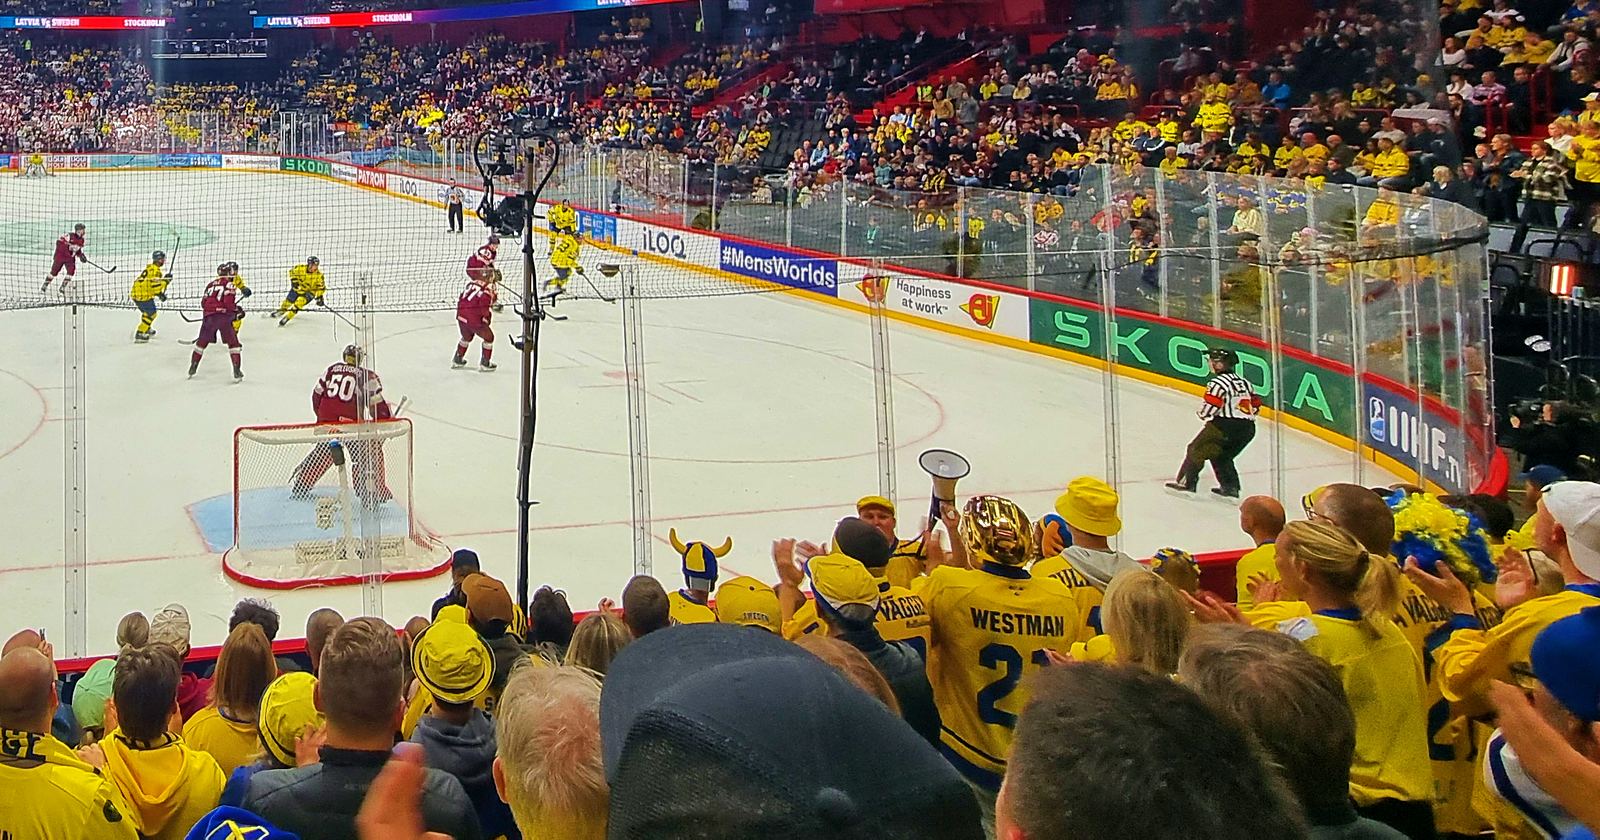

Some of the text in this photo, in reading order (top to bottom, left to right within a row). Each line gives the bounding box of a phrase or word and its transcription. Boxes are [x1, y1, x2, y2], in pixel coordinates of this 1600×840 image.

[52, 18, 80, 26] SWEDEN
[124, 19, 165, 27] STOCKHOLM
[303, 16, 330, 25] SWEDEN
[372, 13, 412, 22] STOCKHOLM
[358, 170, 385, 188] PATRON
[722, 246, 835, 288] #MensWorlds
[896, 278, 951, 299] Happiness
[902, 297, 912, 309] at
[327, 374, 356, 401] 50
[970, 607, 1065, 637] WESTMAN
[977, 643, 1050, 730] 2
